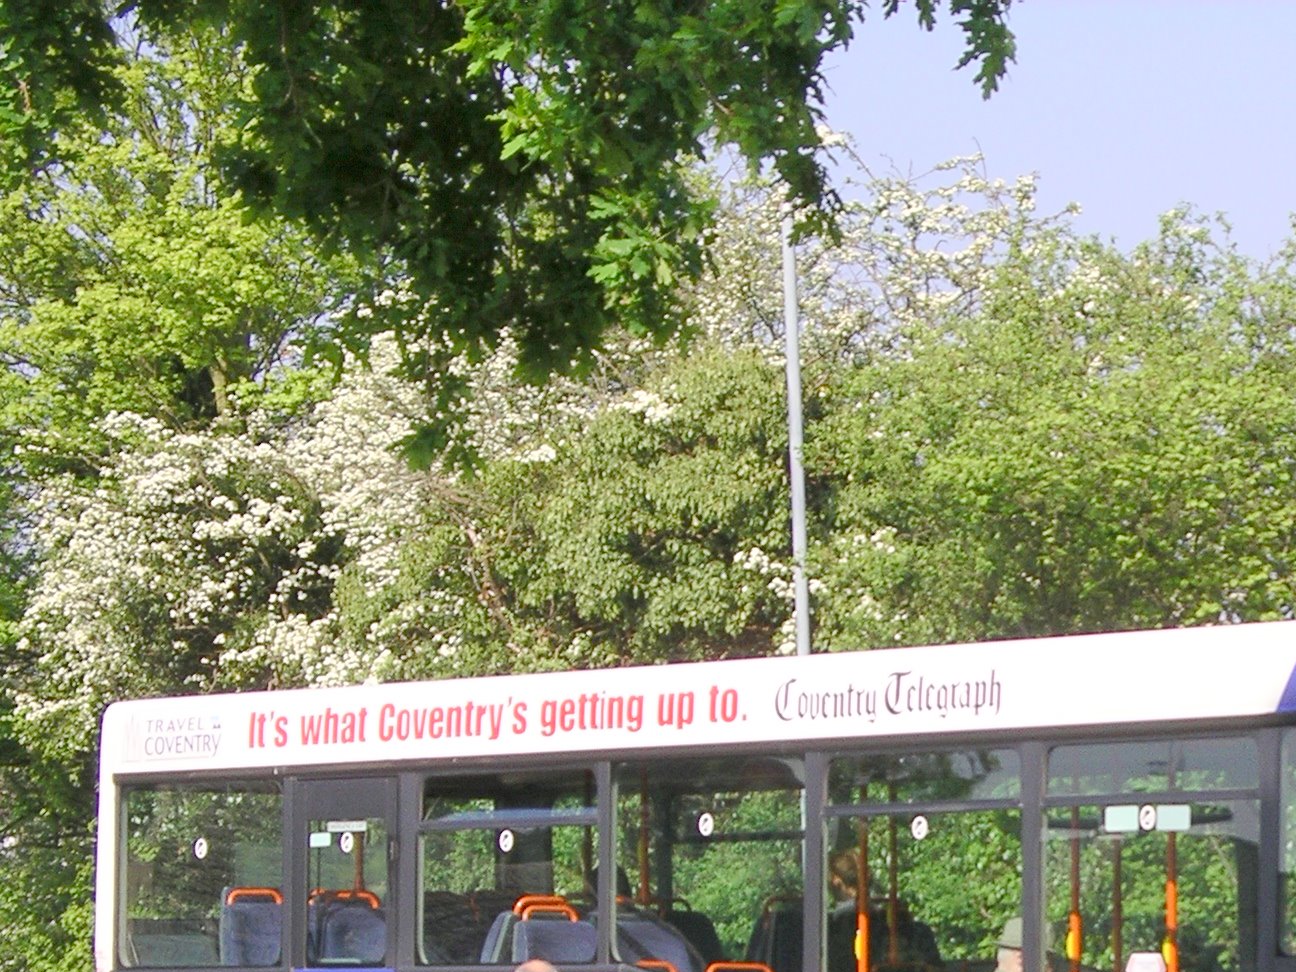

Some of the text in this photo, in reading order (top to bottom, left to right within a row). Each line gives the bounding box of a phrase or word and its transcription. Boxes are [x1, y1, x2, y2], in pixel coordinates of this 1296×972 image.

[775, 669, 1002, 723] Coventry Telegraph
[146, 716, 205, 733] TRAVEL
[249, 685, 747, 748] It's what Coventry's getting up to.
[144, 733, 222, 759] COVENTRY
